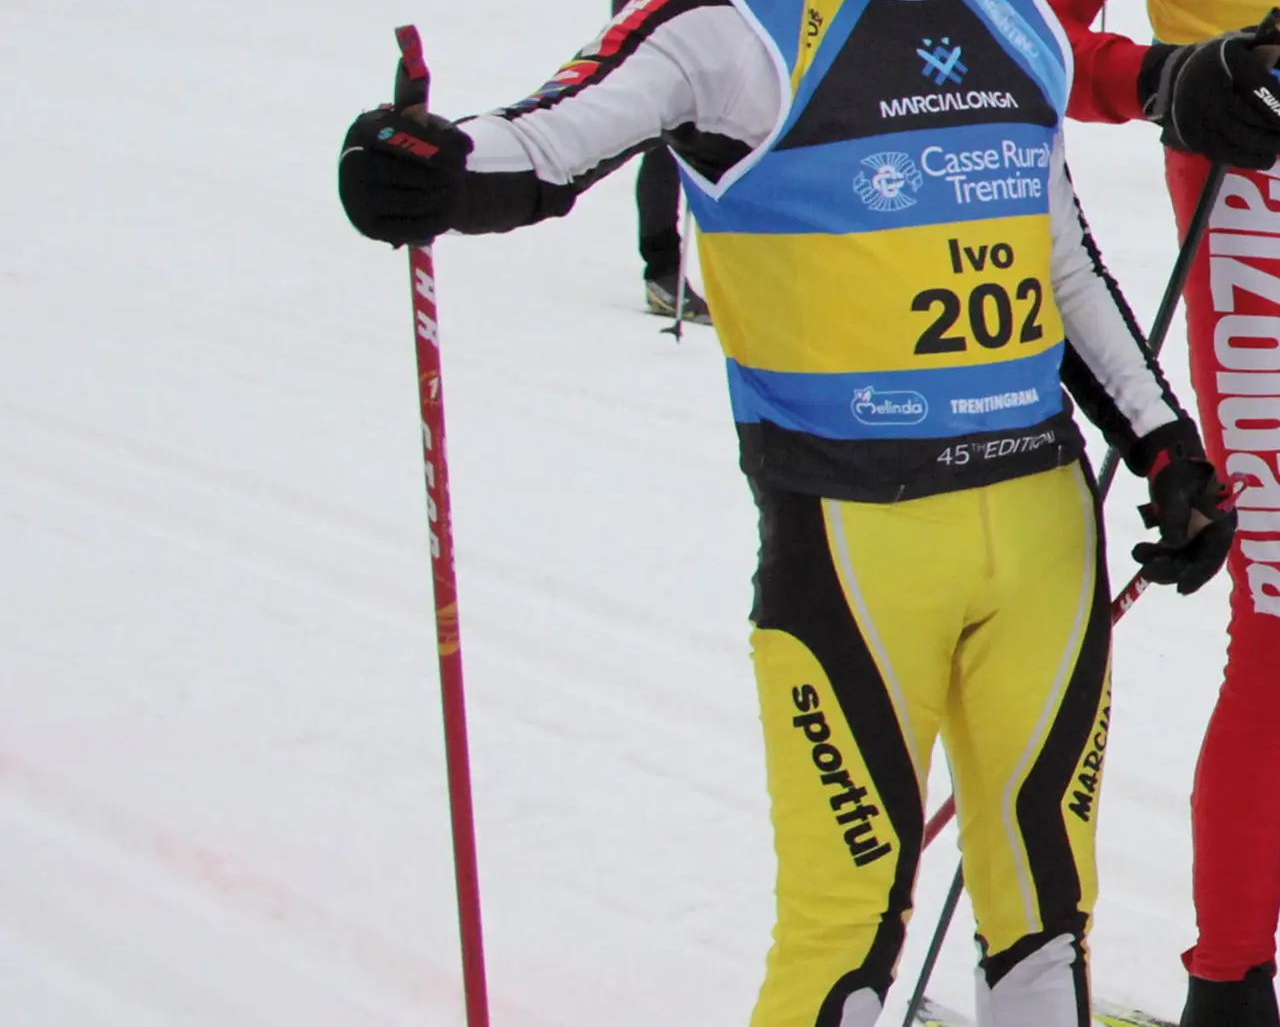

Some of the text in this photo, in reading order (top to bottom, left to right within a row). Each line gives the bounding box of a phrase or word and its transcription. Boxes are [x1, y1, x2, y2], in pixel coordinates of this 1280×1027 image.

[879, 90, 1018, 118] MARCIALONGA
[921, 145, 1001, 177] Casse
[946, 172, 1041, 204] Trentine
[948, 238, 1014, 273] Ivo
[910, 278, 1043, 355] 202
[856, 400, 923, 415] Melinda
[950, 387, 1039, 414] TRENTINGRANA
[792, 683, 892, 867] sportful
